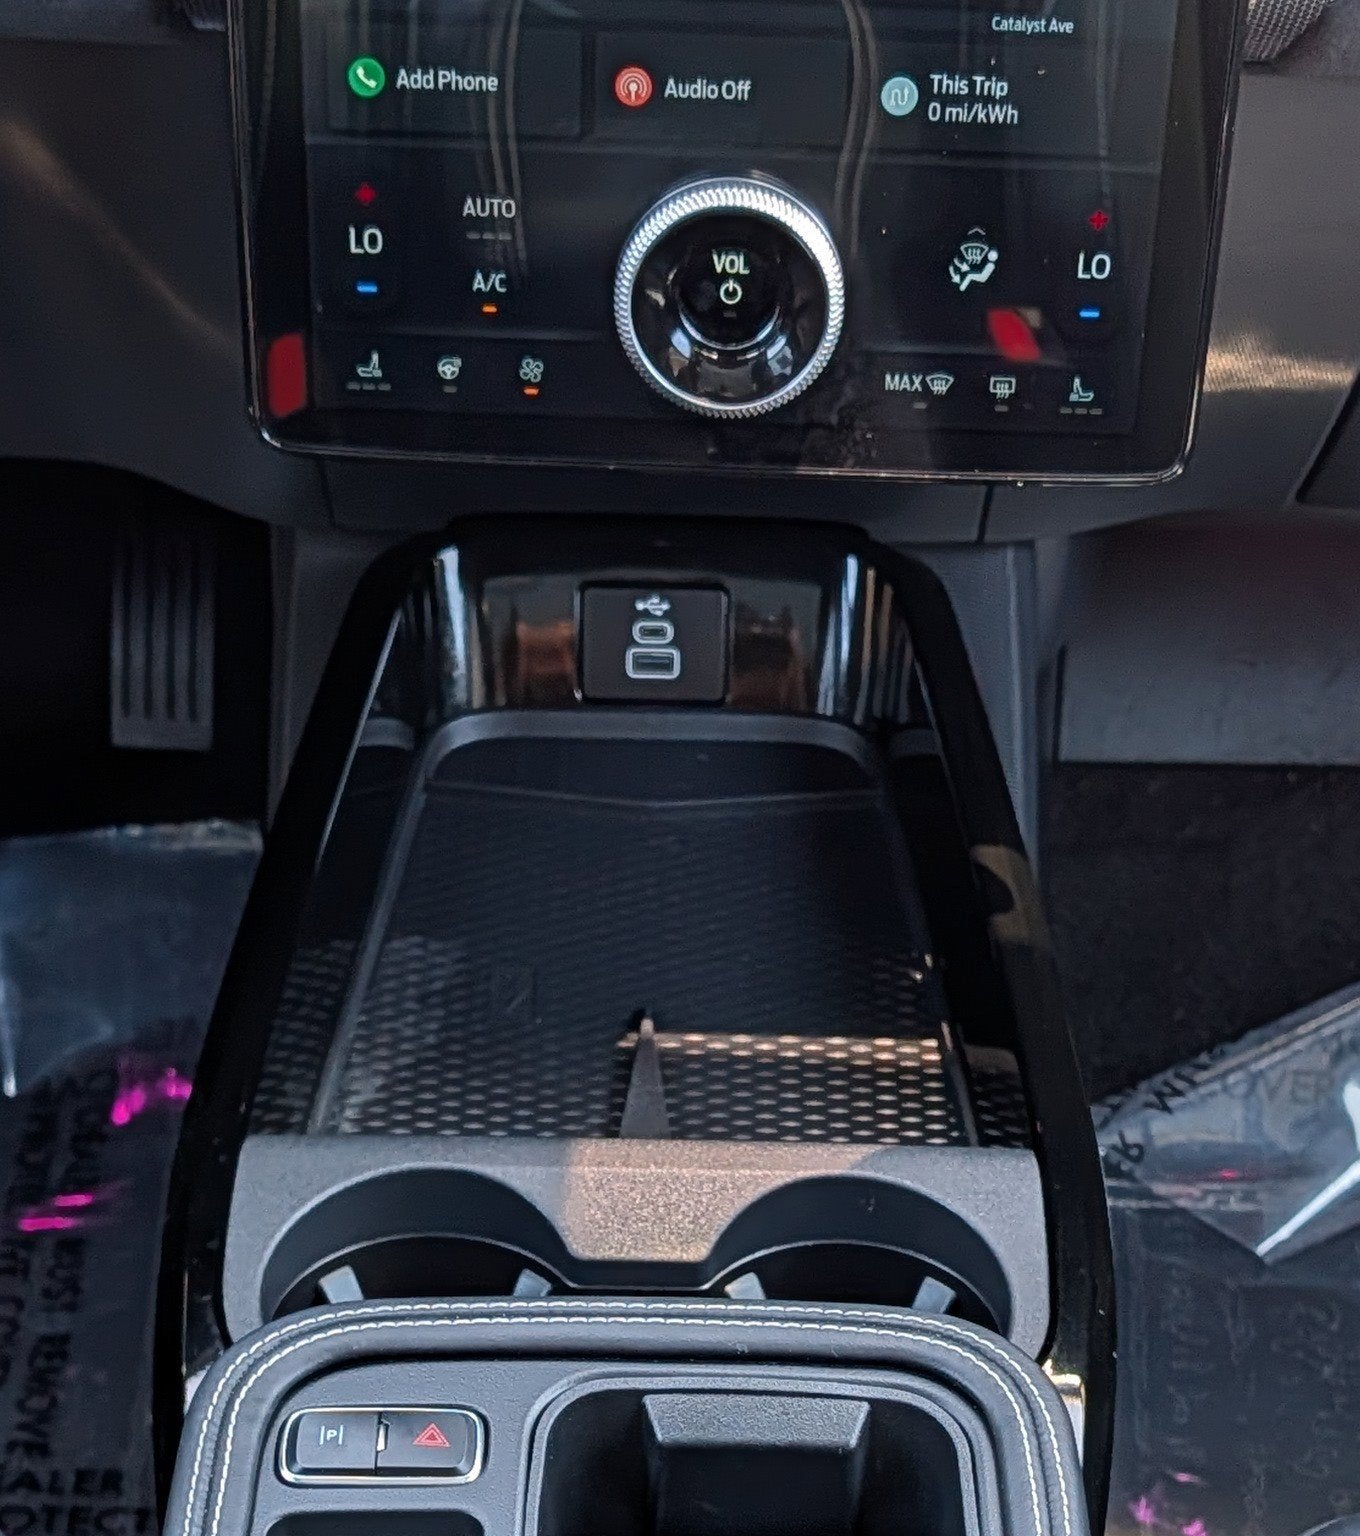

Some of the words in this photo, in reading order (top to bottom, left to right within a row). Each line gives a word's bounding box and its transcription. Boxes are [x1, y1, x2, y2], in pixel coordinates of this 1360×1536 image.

[992, 16, 1047, 34] Catalyst
[1048, 17, 1074, 33] Ave
[396, 68, 434, 90] Add
[439, 69, 499, 91] Phone
[664, 77, 719, 100] Audio
[722, 80, 751, 101] Off
[929, 74, 969, 95] This
[972, 75, 1009, 100] Trip
[928, 102, 941, 122] 0
[945, 103, 1018, 124] mi/kWh
[462, 196, 516, 218] AUTO
[348, 225, 383, 254] LO
[712, 250, 750, 274] VOL
[1077, 251, 1111, 279] LO
[472, 270, 507, 293] A/C
[884, 372, 924, 392] MAX
